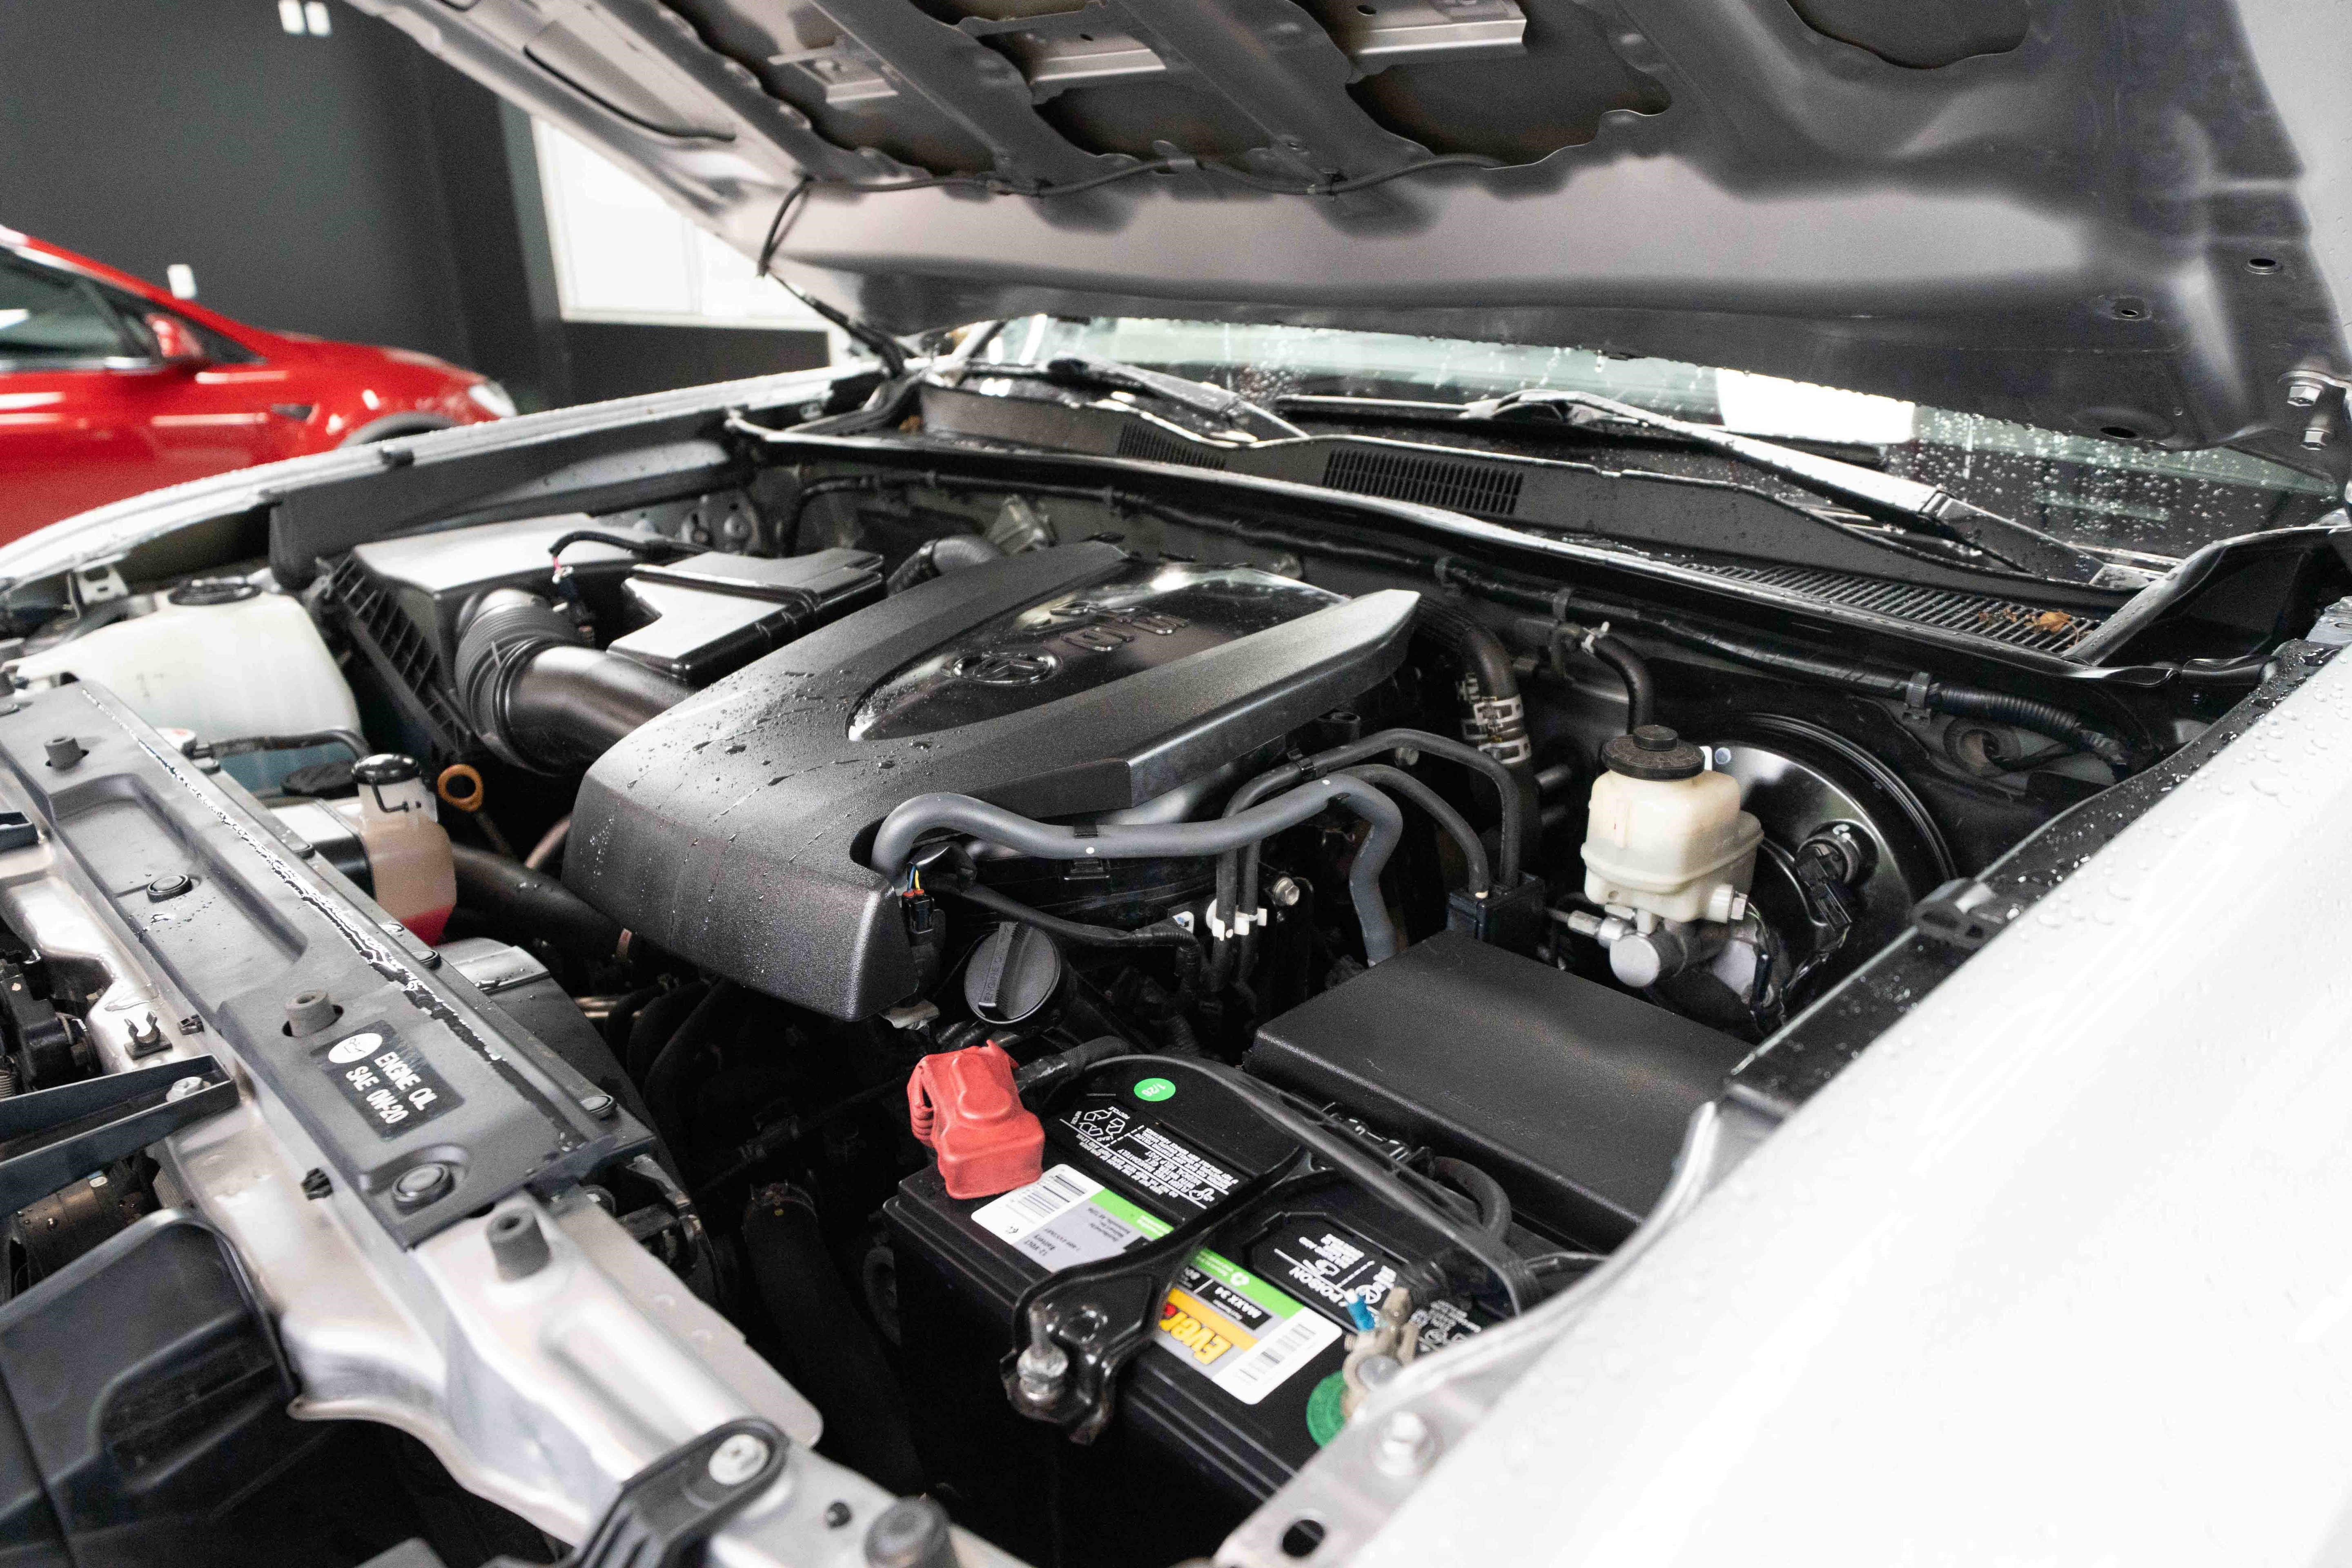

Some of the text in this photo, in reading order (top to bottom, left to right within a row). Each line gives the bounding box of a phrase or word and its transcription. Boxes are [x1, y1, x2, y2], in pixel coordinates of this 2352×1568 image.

[346, 1065, 408, 1124] SAE 0W-20
[374, 1051, 437, 1111] ENGINE OIL
[1213, 1286, 1263, 1318] MAXX 34
[1287, 1266, 1344, 1302] POISON
[1159, 1304, 1232, 1364] Ever
